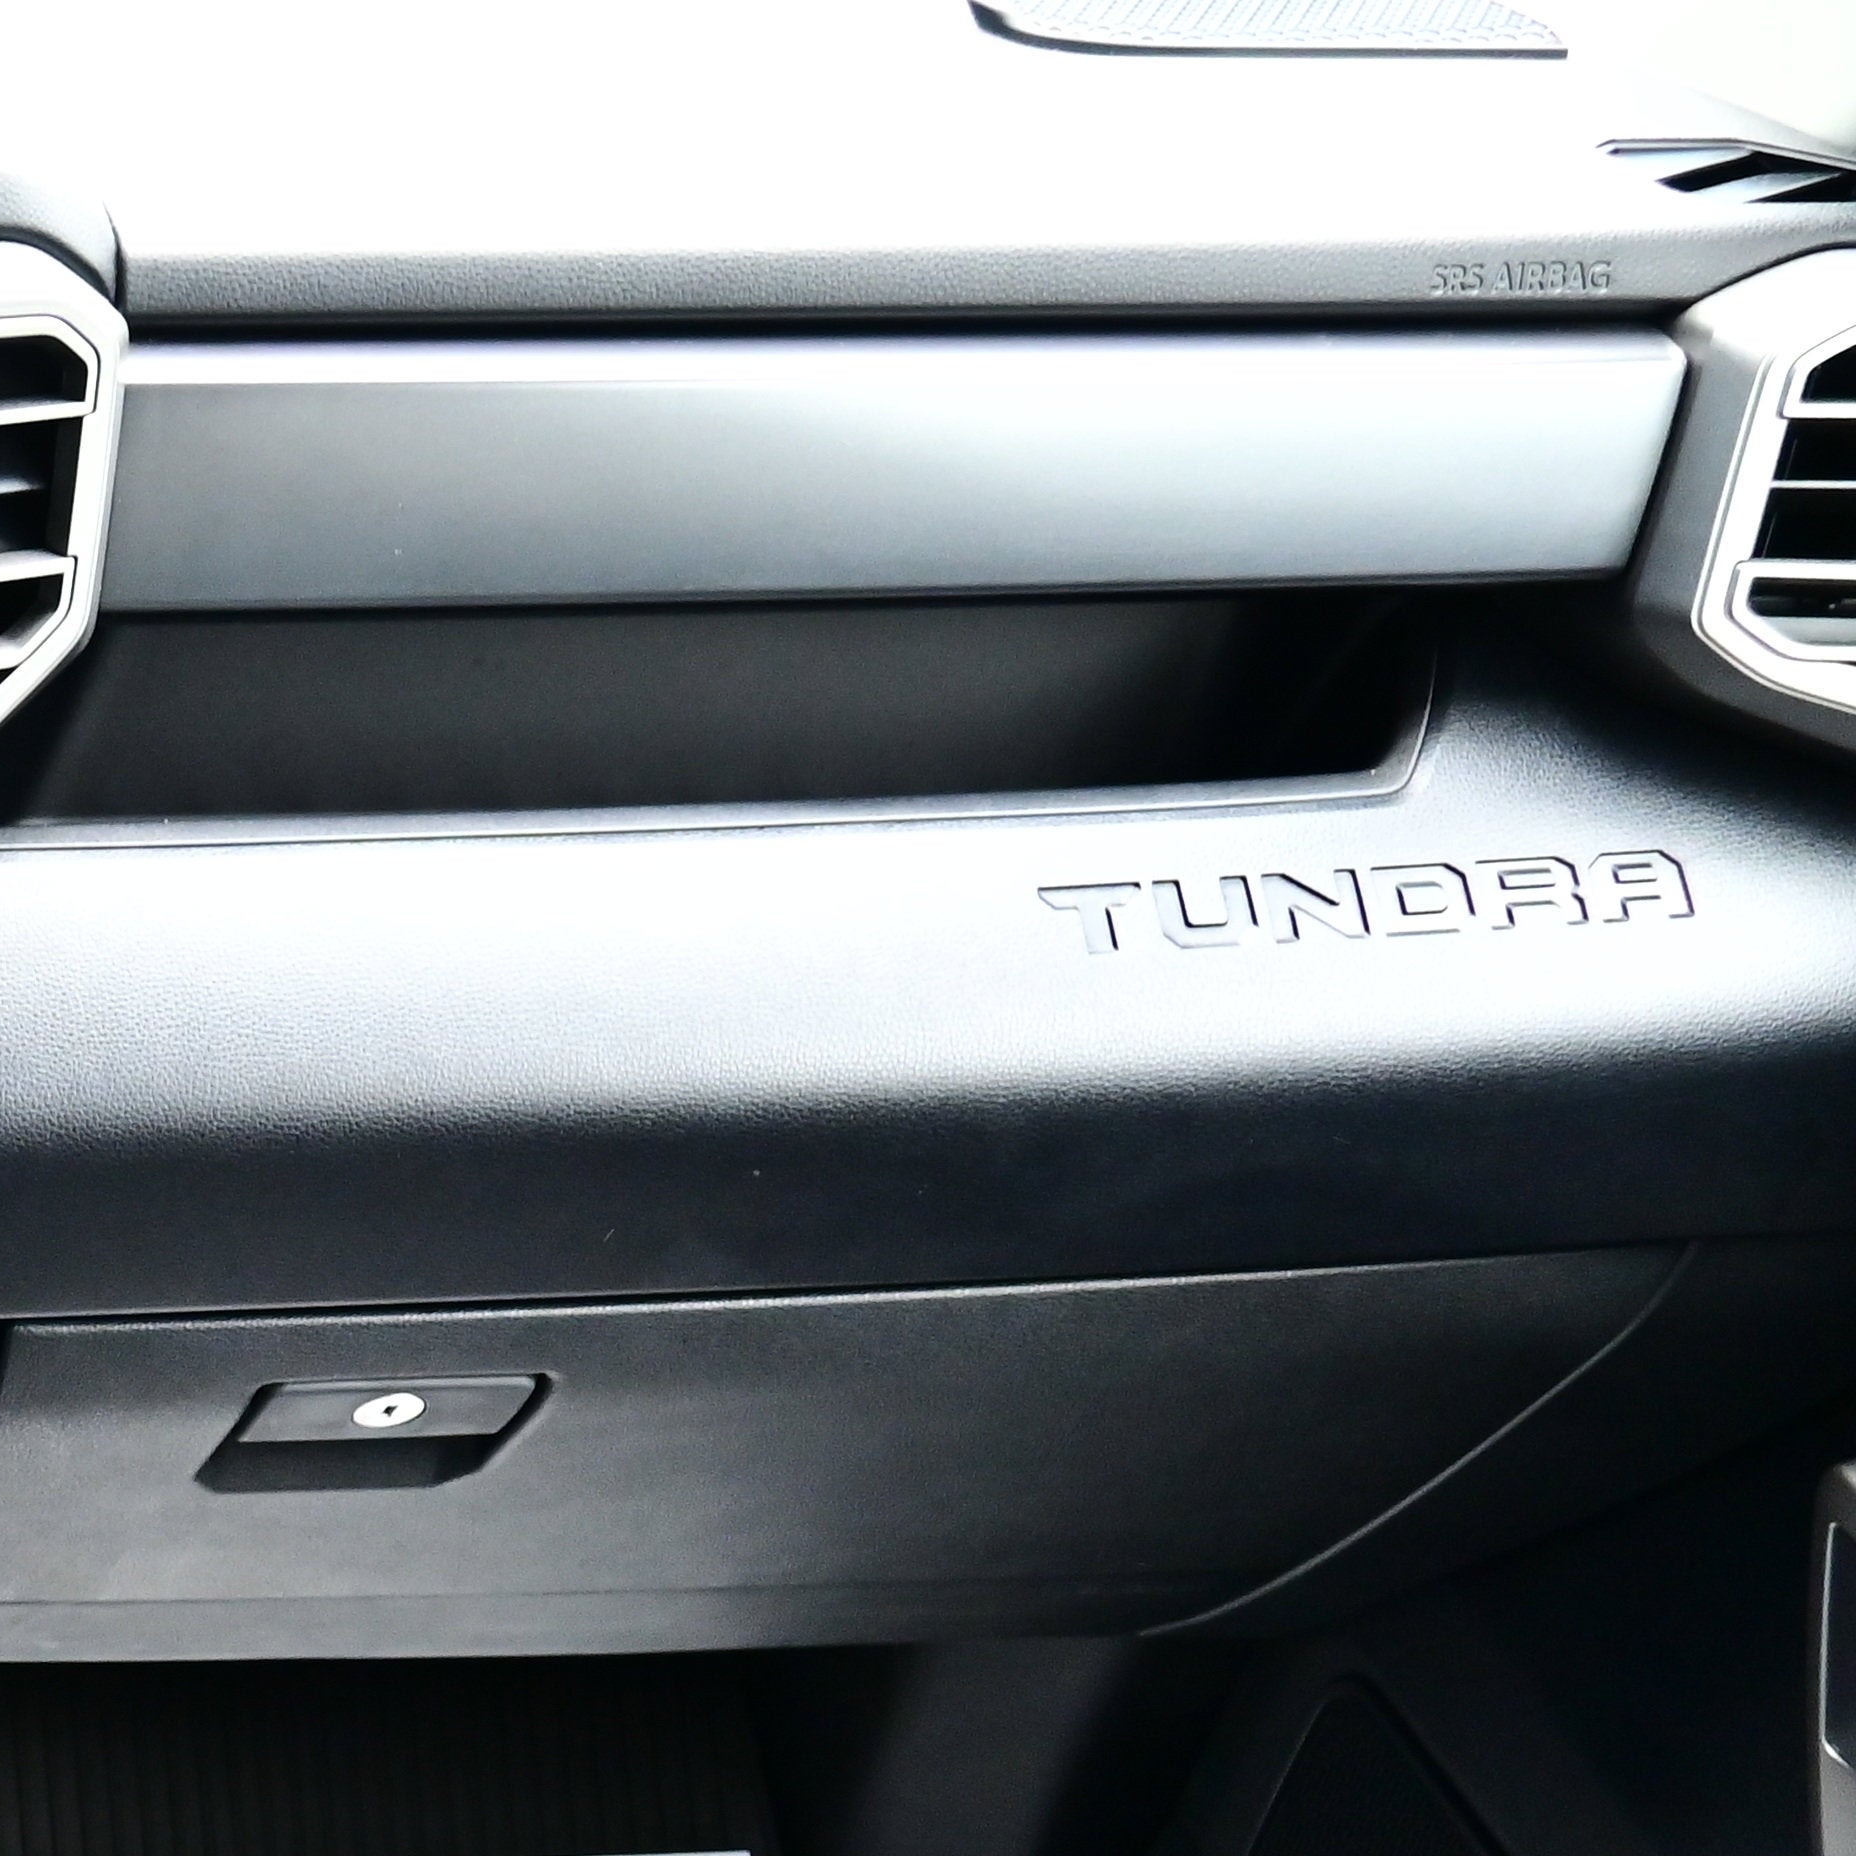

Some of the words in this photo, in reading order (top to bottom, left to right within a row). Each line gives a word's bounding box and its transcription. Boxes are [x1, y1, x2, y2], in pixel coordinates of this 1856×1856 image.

[1430, 262, 1485, 296] SRS
[1491, 260, 1613, 296] AIRBAG
[1036, 848, 1696, 954] TUNDRA
